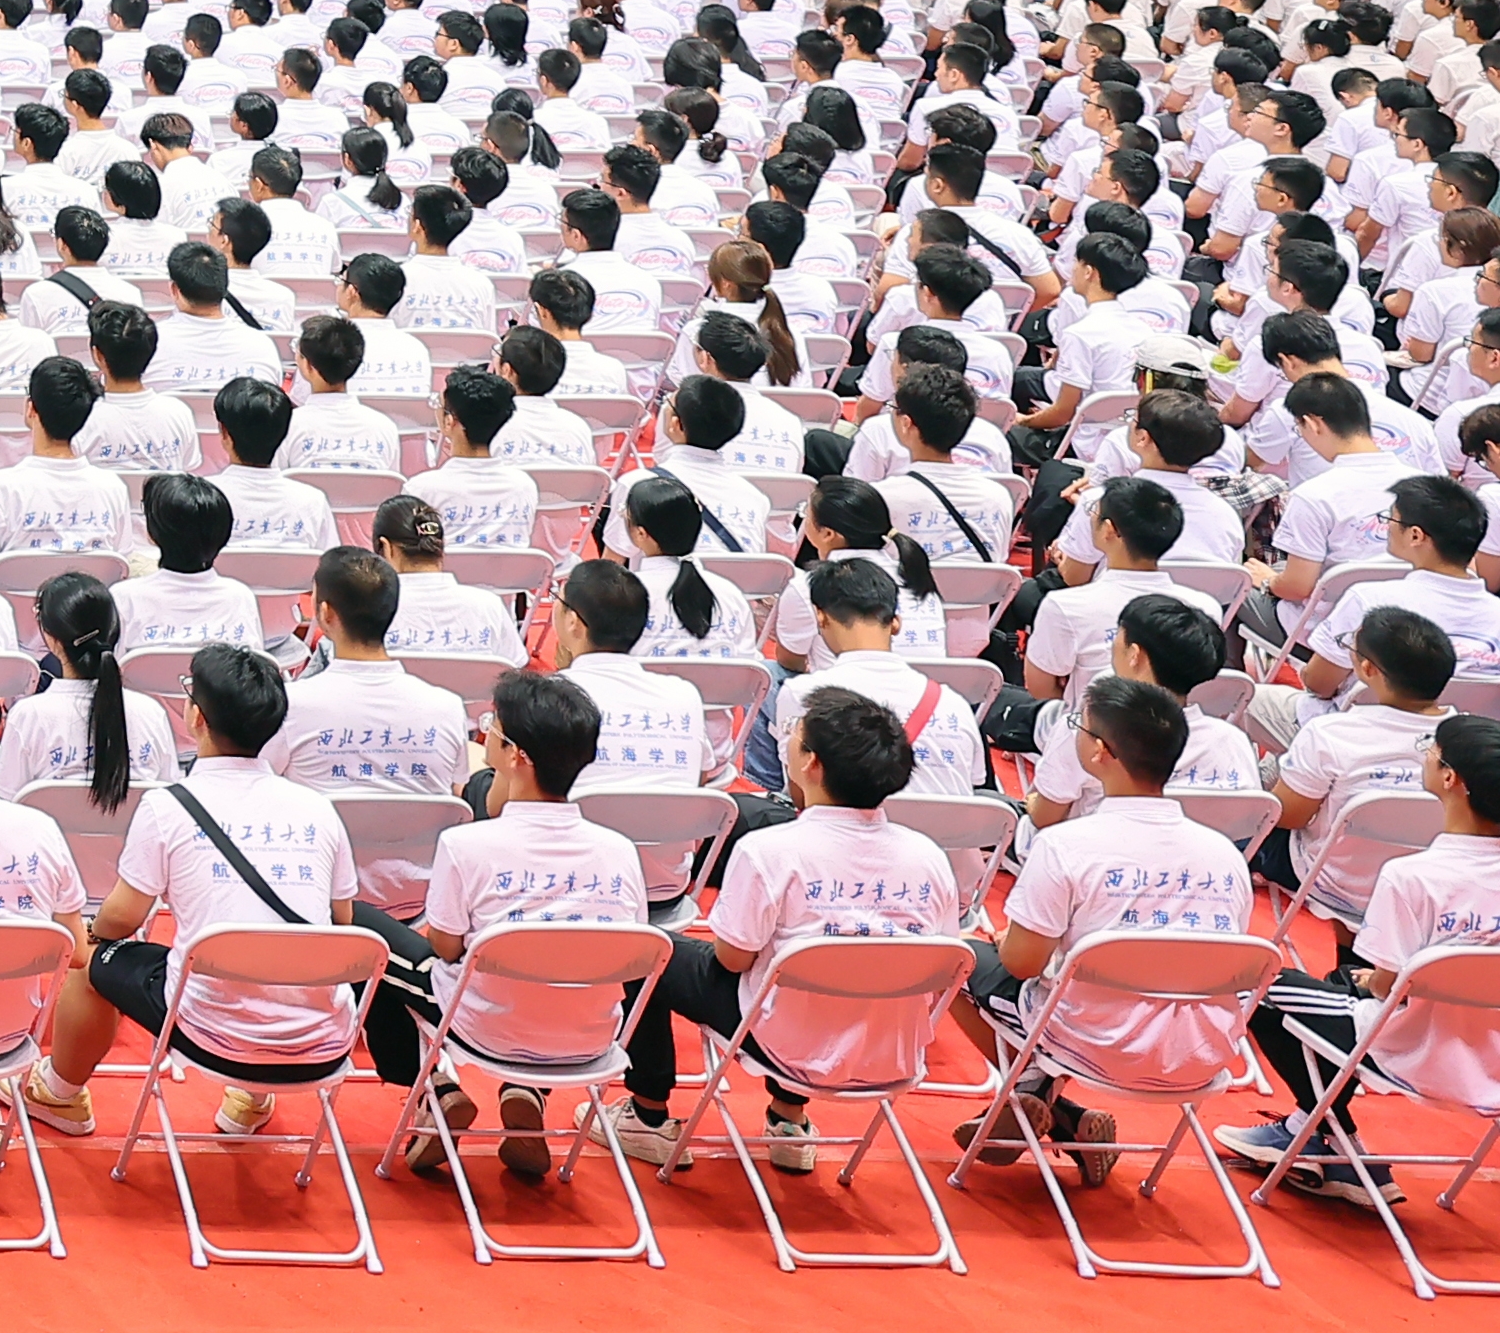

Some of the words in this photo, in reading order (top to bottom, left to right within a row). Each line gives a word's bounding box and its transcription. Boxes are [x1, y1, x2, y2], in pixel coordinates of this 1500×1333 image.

[330, 762, 428, 778] 航海学院
[213, 861, 314, 882] 航学院
[1121, 909, 1233, 931] 航海学院
